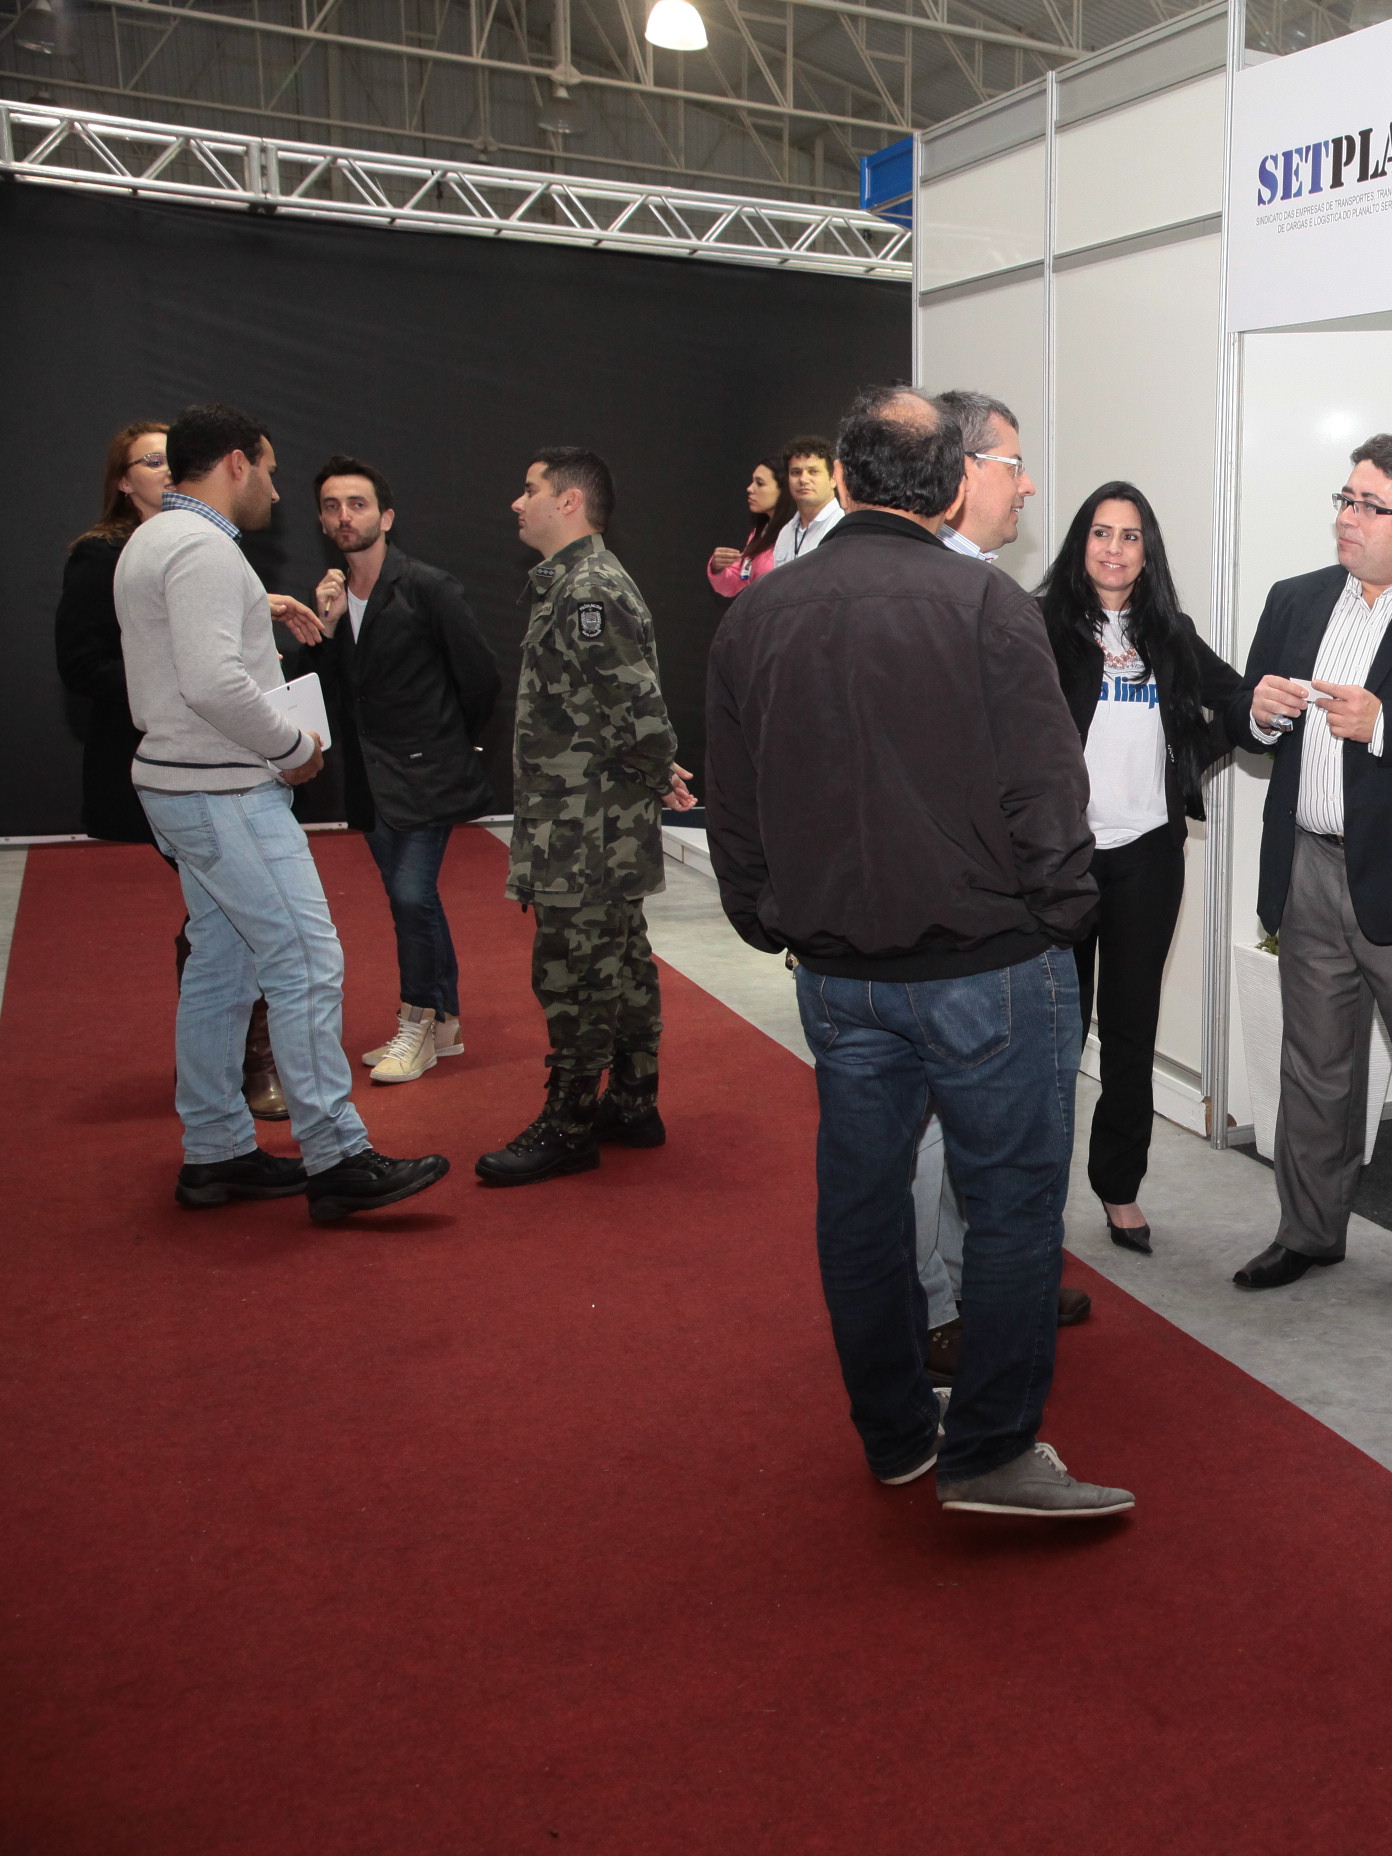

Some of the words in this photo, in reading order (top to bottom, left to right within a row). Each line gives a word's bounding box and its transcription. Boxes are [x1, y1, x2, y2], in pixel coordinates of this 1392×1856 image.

[1256, 213, 1282, 226] SINDICATO
[1284, 210, 1295, 222] DAS
[1296, 205, 1325, 217] EMPRESAS
[1326, 201, 1334, 211] DE
[1278, 224, 1285, 233] DE
[1286, 219, 1308, 232] CARGAS
[1352, 202, 1380, 217] PLANALTO
